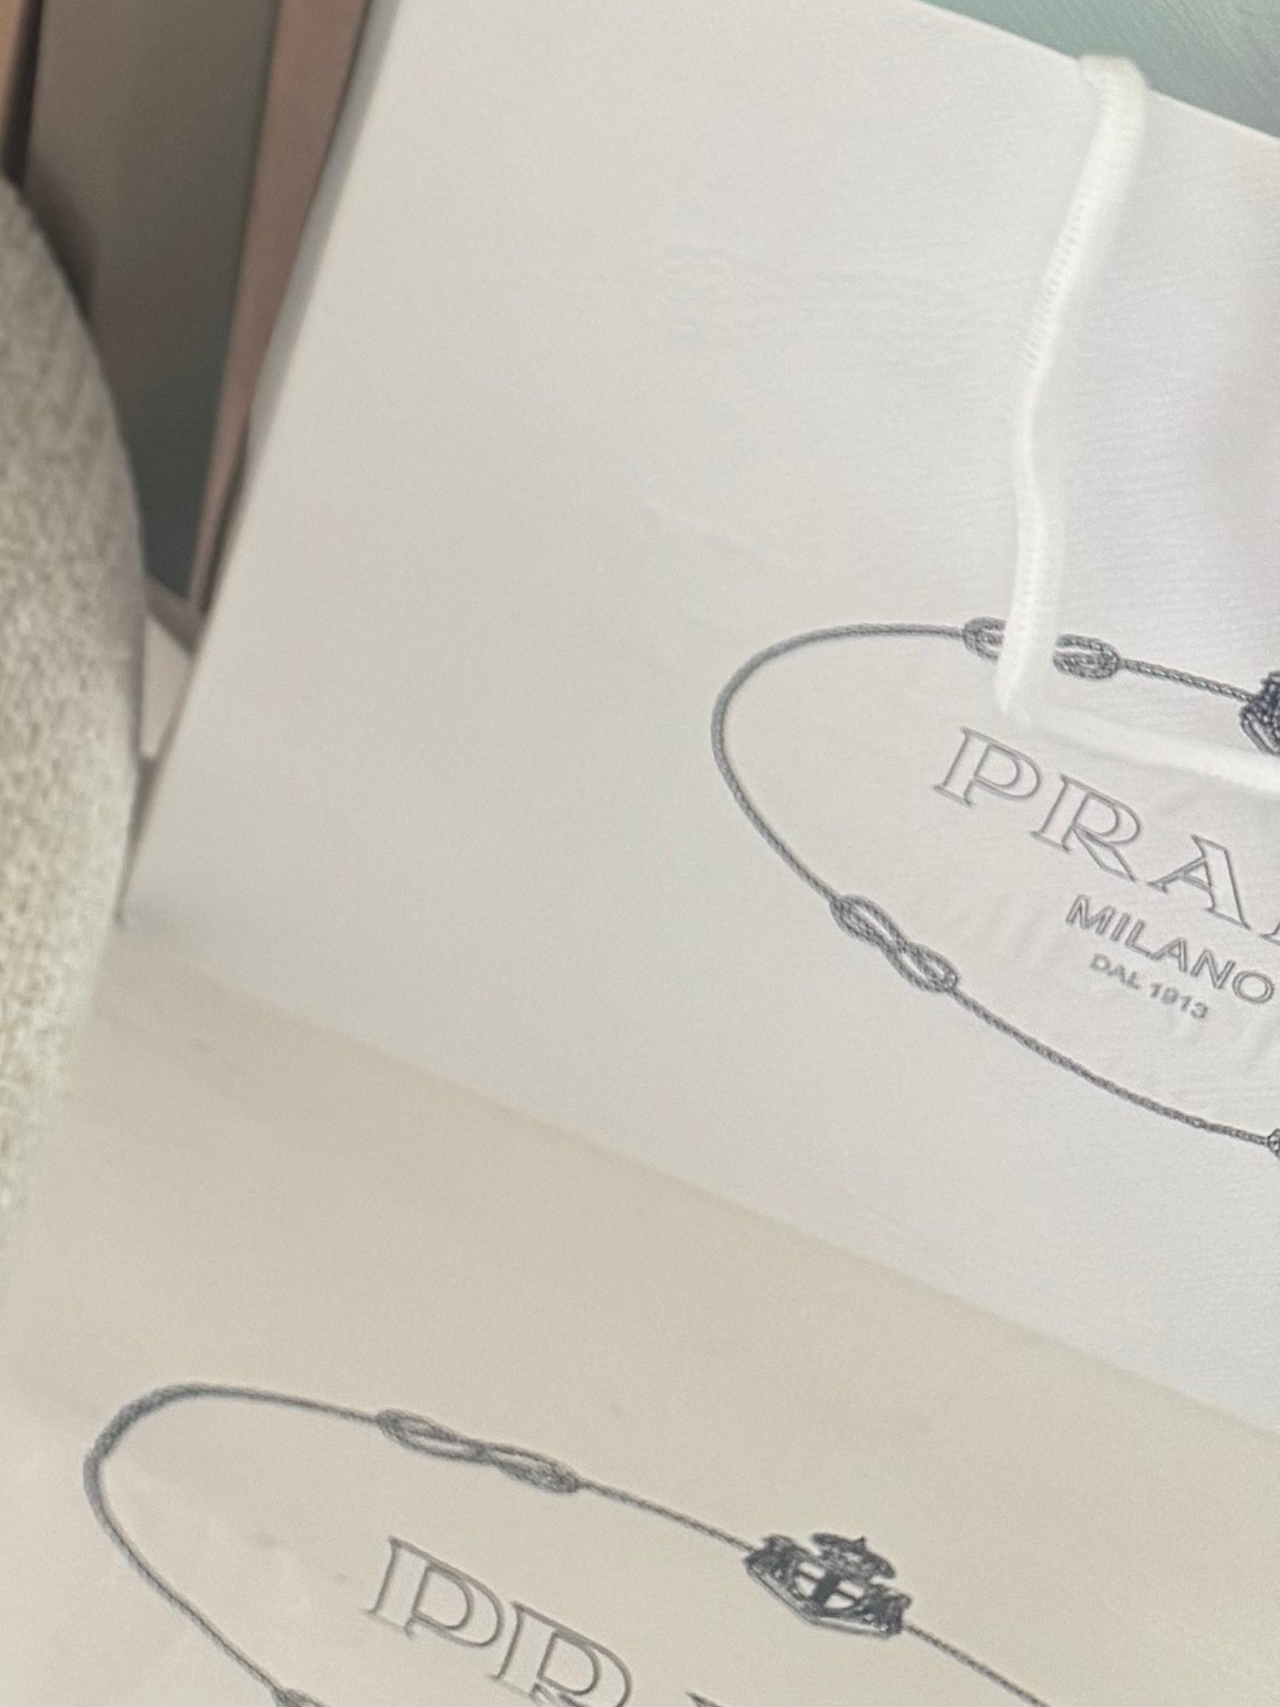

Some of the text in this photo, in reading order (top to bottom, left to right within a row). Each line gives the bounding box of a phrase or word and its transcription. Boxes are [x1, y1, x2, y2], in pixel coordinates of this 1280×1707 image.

[933, 727, 1280, 945] PRA
[1065, 893, 1275, 1004] MILANO
[1089, 952, 1209, 1019] DAL 1913
[364, 1536, 724, 1707] PR
